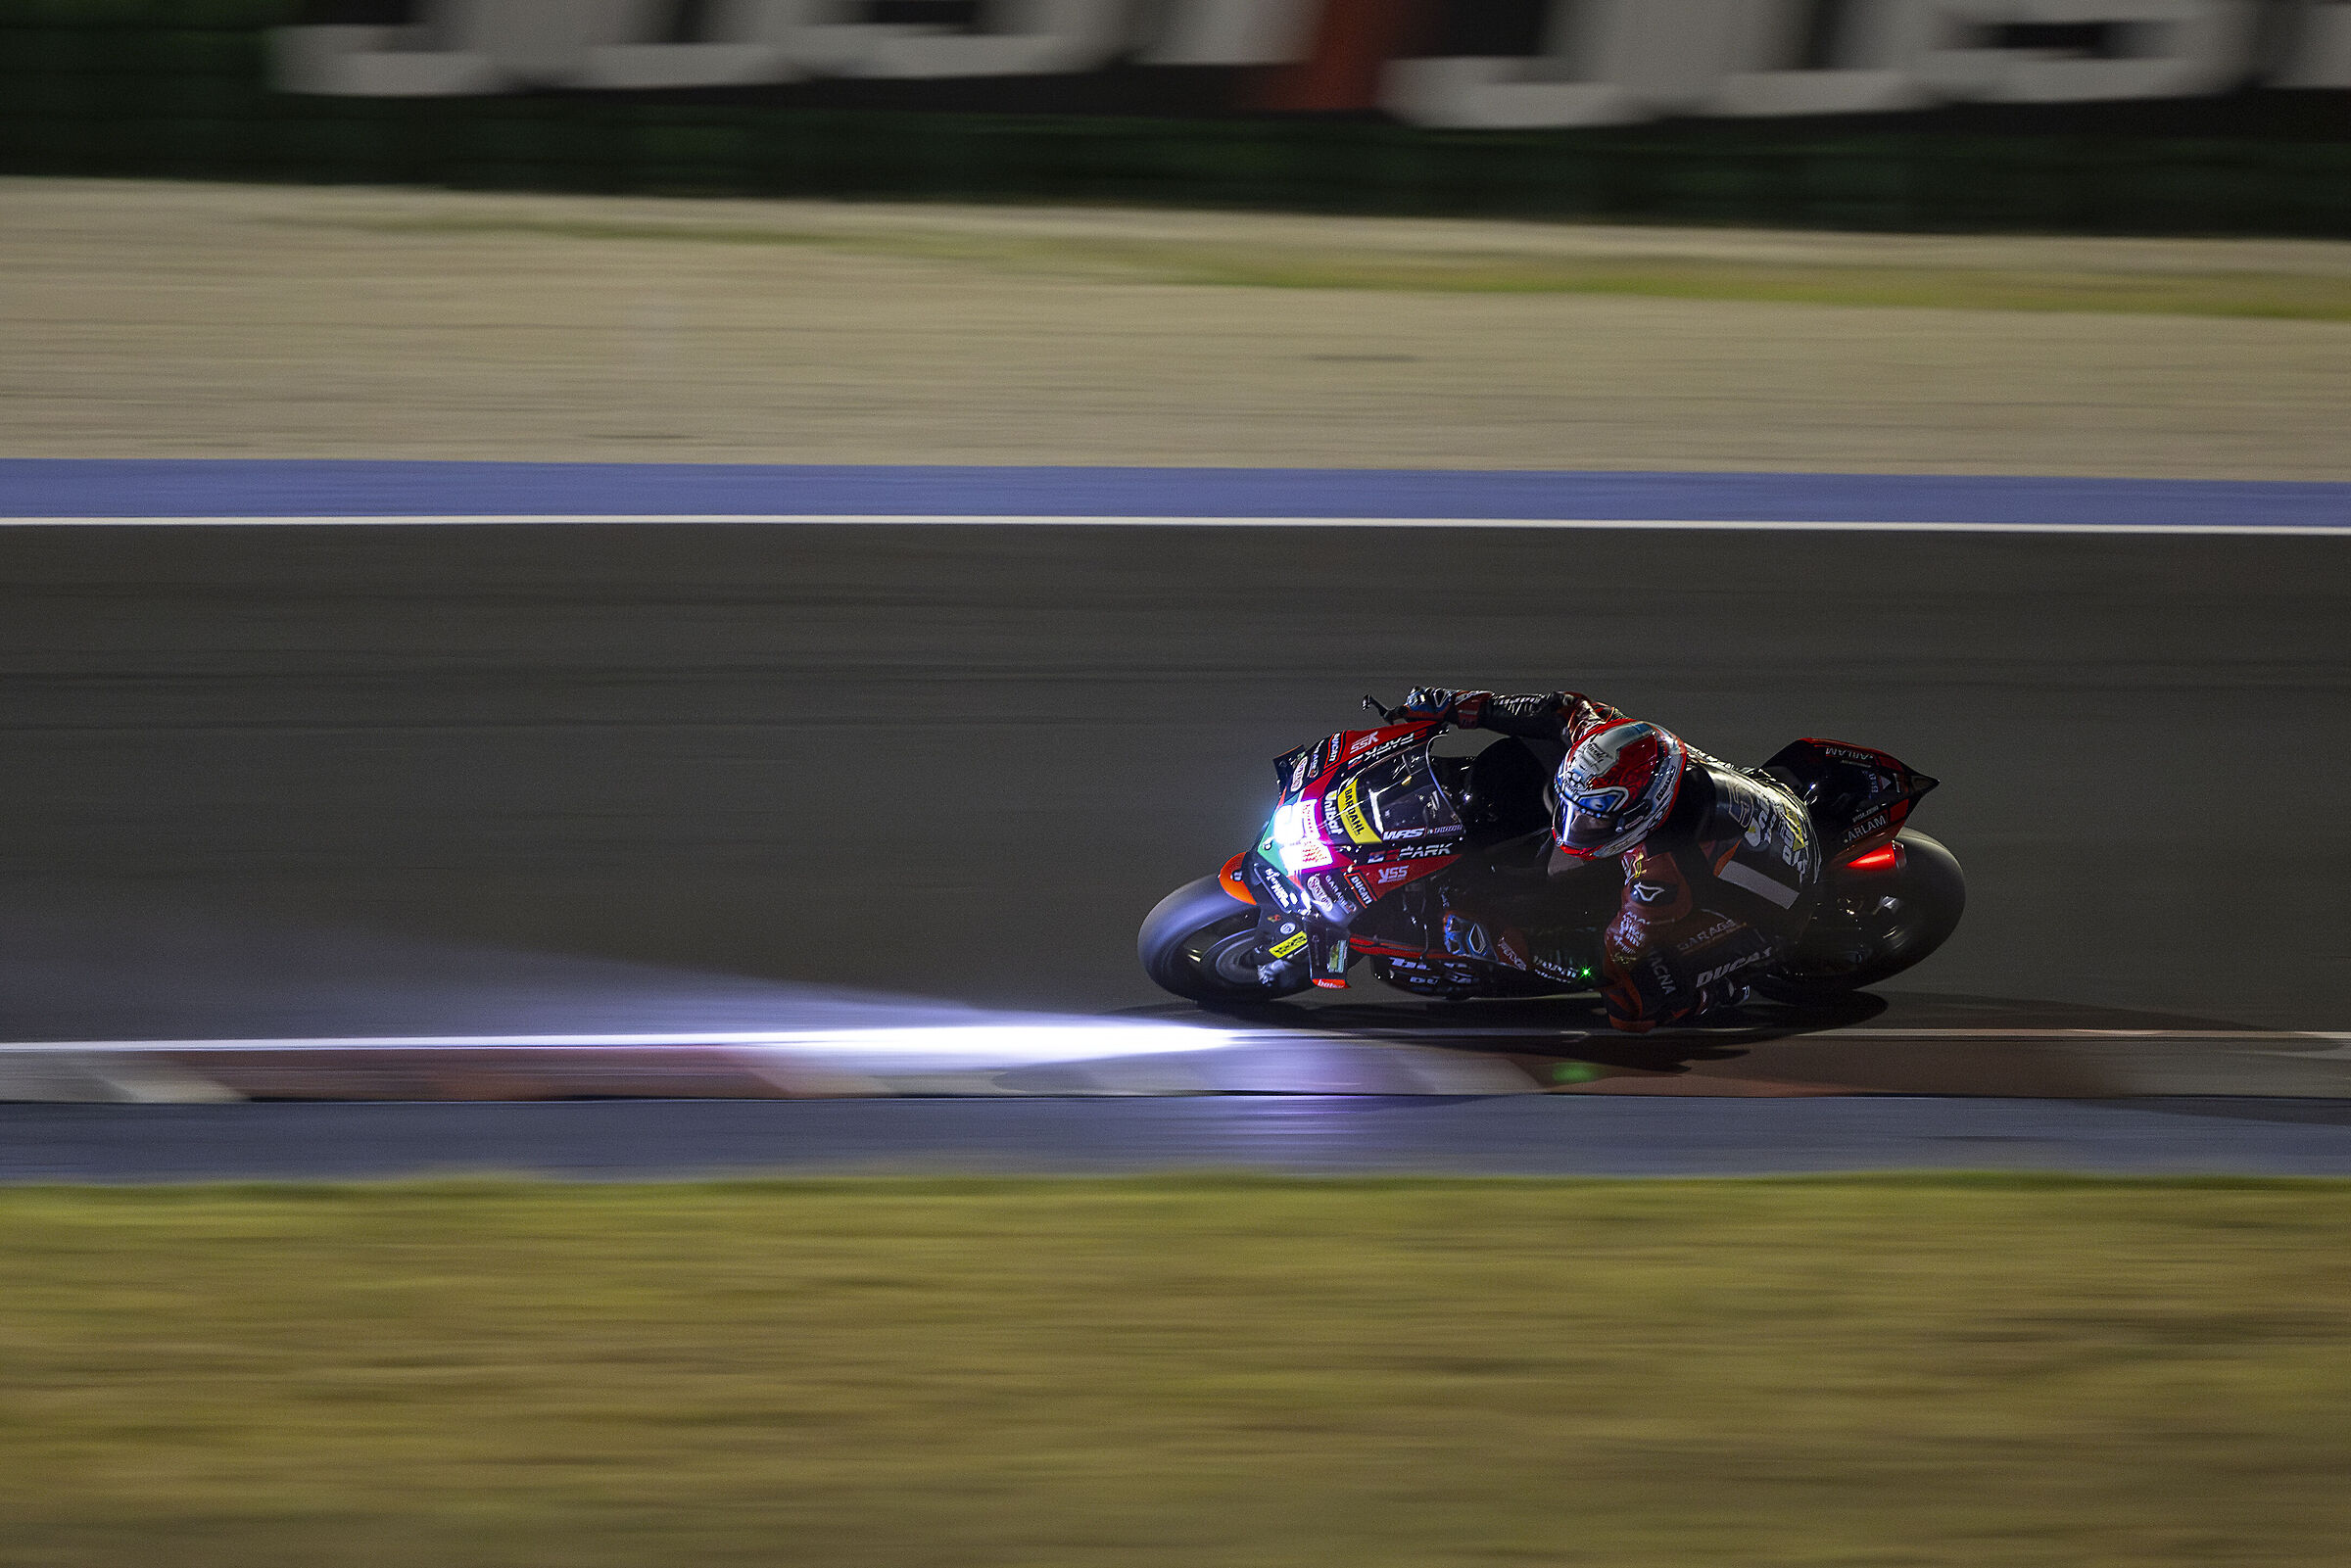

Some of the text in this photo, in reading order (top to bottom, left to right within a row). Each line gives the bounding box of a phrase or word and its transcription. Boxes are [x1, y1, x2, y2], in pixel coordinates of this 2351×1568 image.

[1344, 787, 1365, 835] BARDAHL
[1378, 865, 1410, 883] YSS
[1351, 876, 1372, 905] DUCATI
